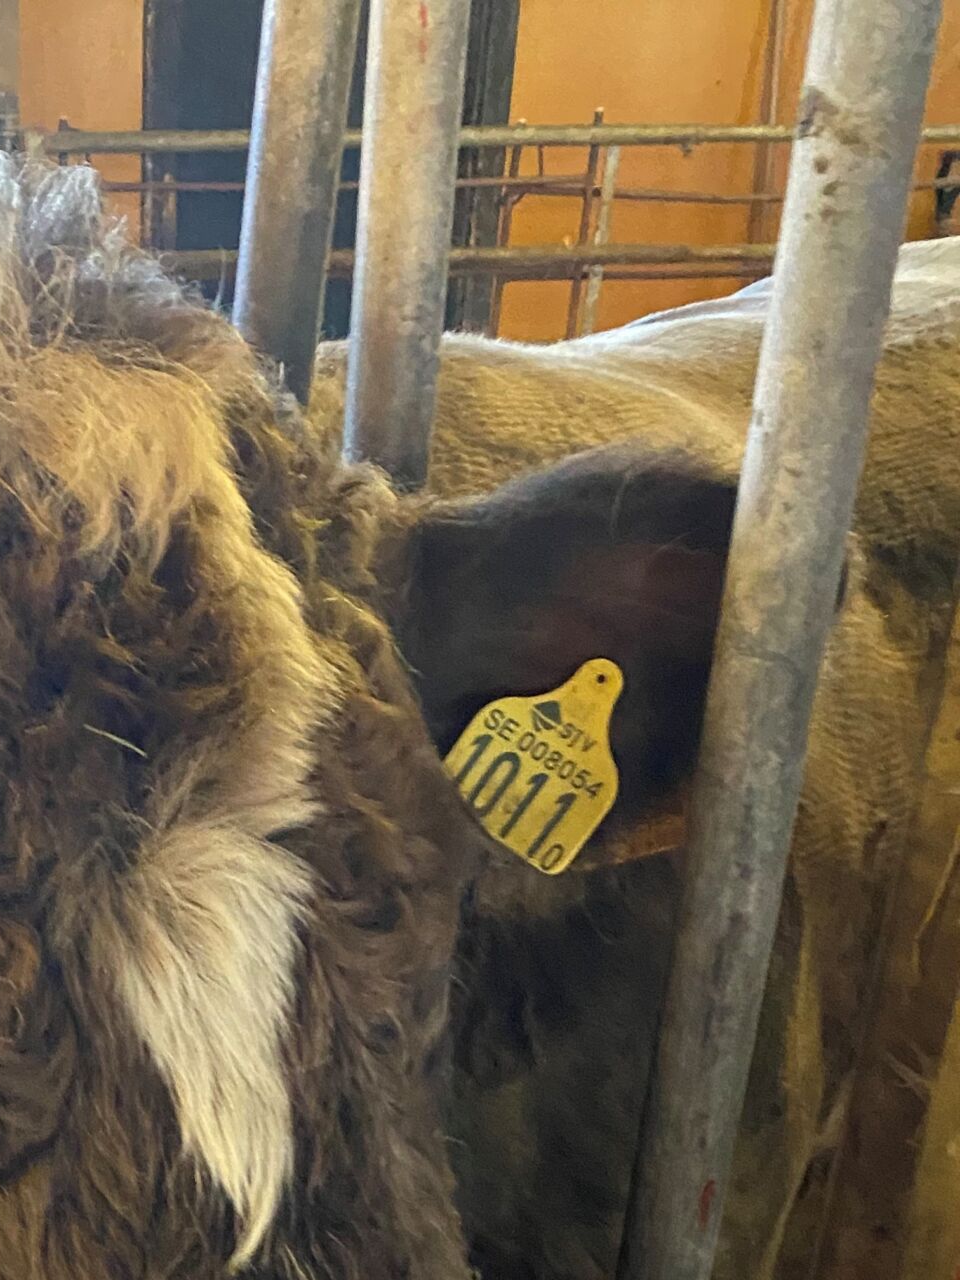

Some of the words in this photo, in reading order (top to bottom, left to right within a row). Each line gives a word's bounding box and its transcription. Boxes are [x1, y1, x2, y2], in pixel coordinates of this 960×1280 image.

[484, 708, 520, 741] SE
[518, 732, 604, 799] 008054
[559, 722, 597, 752] STV
[456, 734, 577, 858] 1011
[540, 844, 565, 870] 0
